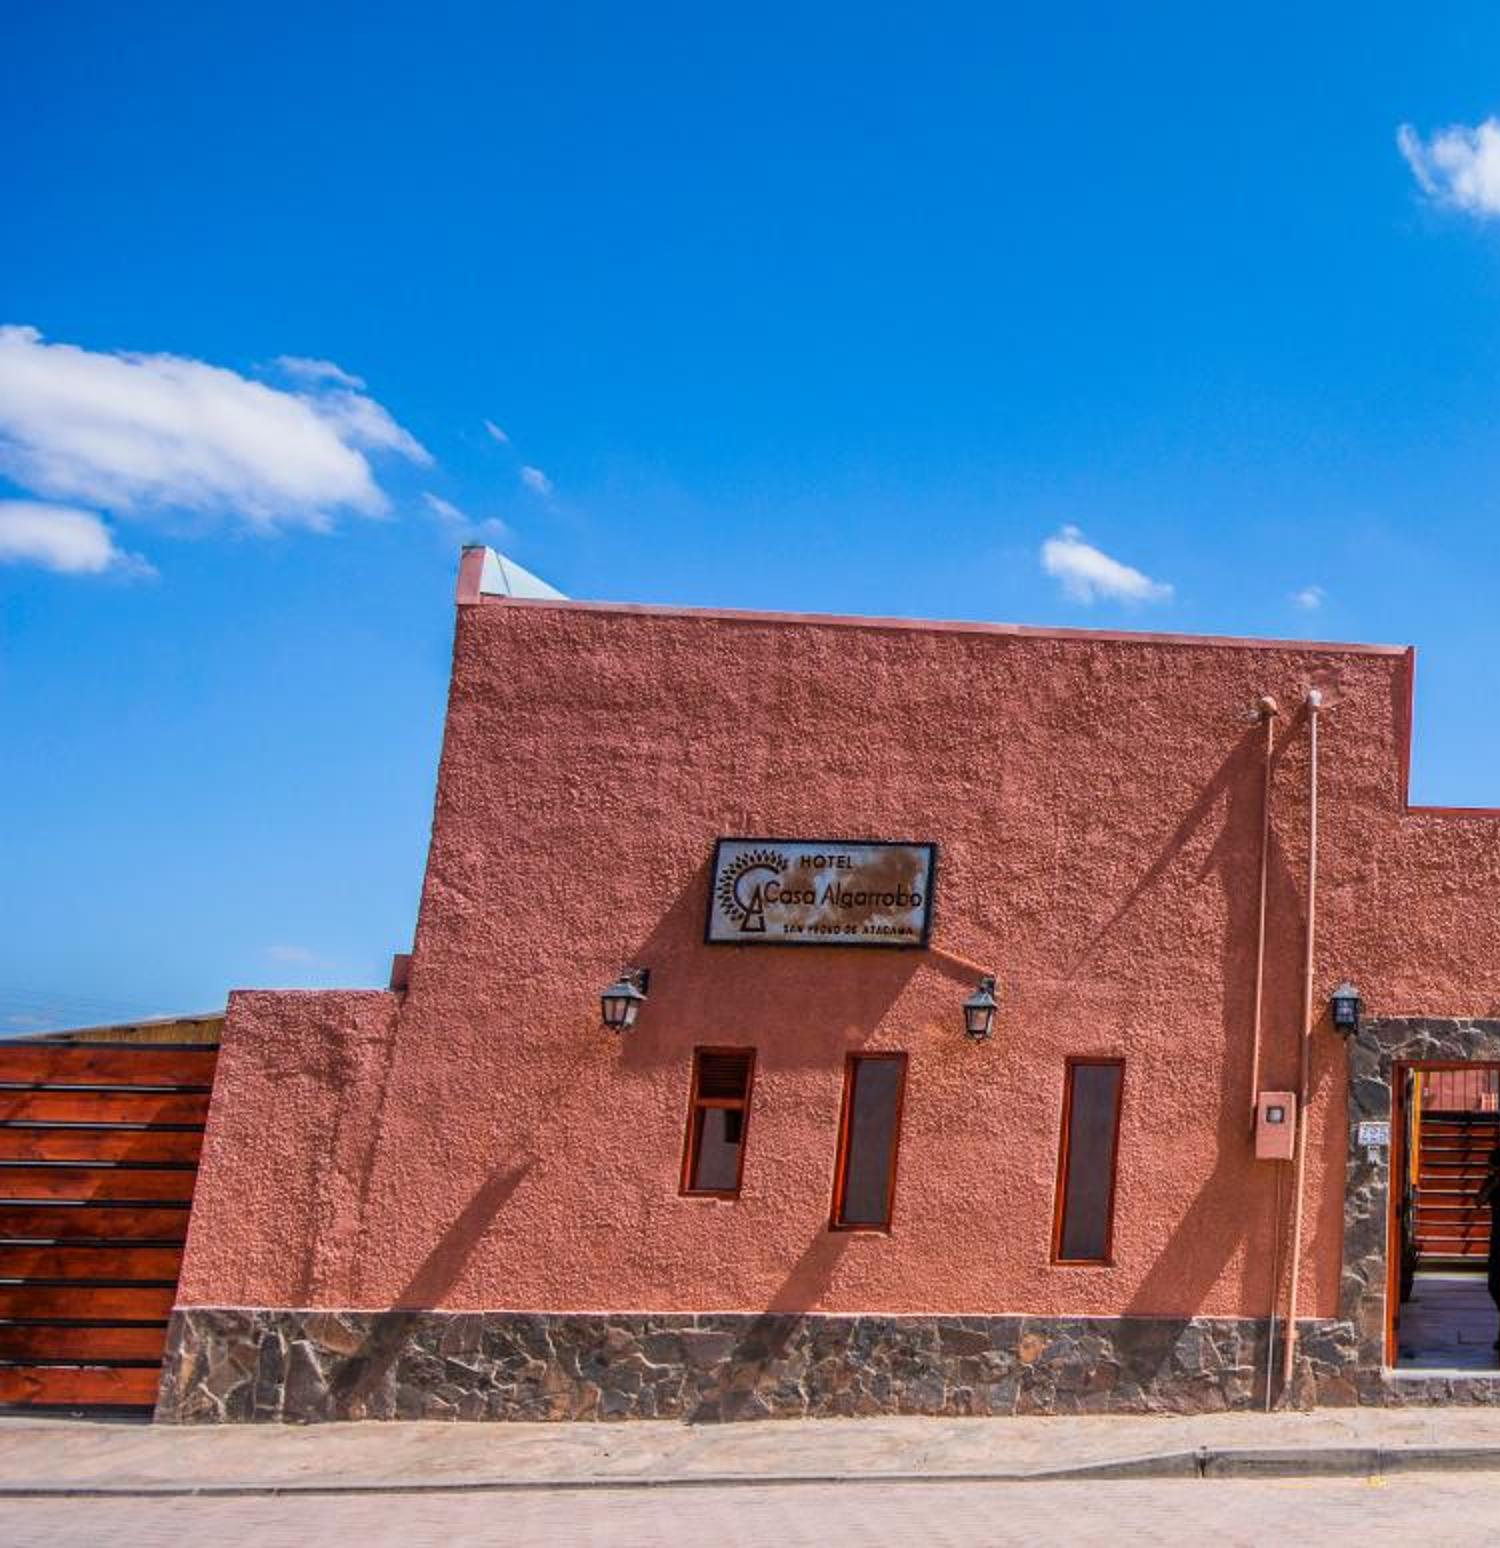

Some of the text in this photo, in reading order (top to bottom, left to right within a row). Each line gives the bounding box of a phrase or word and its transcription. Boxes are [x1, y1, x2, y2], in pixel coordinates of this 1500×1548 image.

[801, 855, 853, 869] HOTEL
[764, 880, 923, 909] Casa Algarrobo
[783, 924, 803, 933] SAN
[843, 925, 858, 935] DE
[862, 925, 913, 935] ATACAMA
